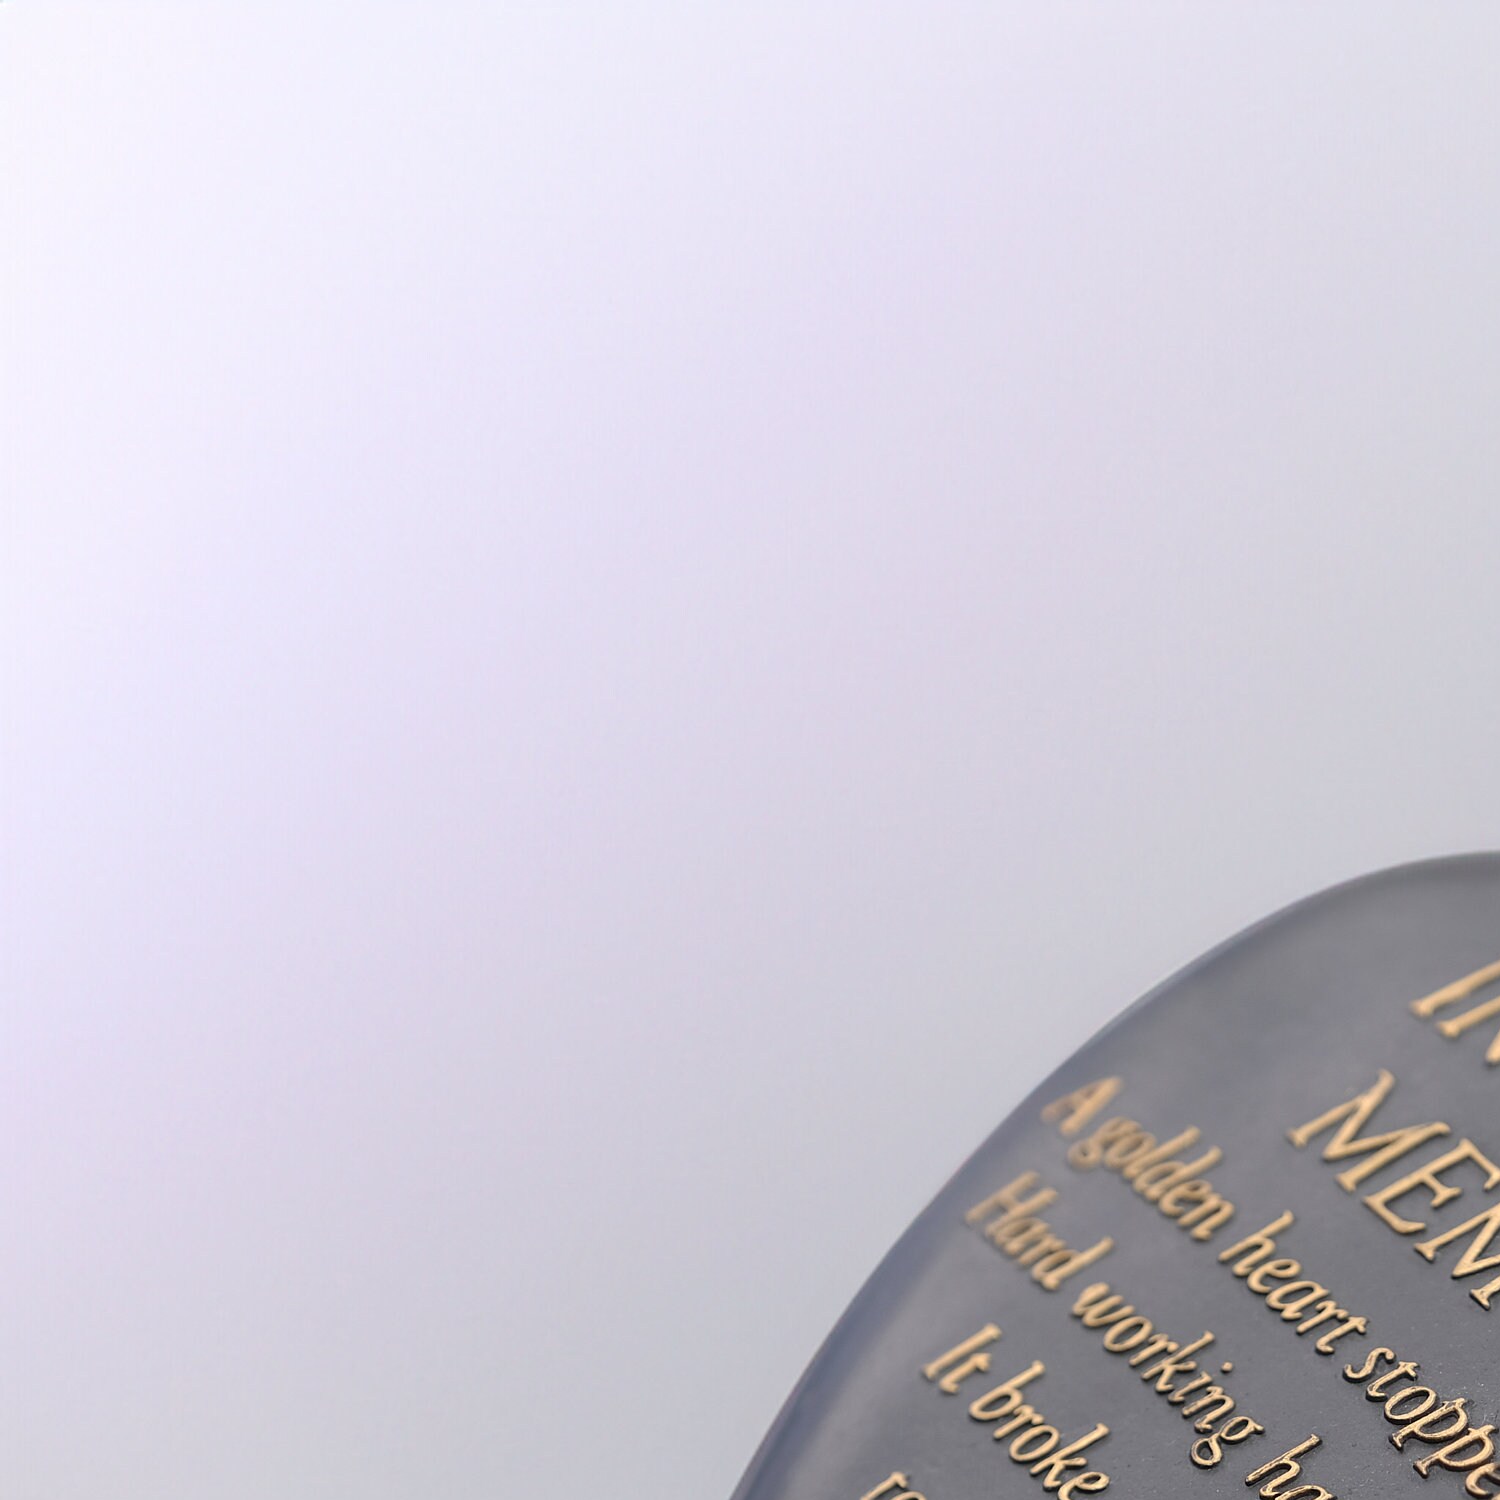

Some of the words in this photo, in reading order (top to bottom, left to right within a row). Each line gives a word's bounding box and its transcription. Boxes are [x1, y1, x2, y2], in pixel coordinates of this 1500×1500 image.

[1040, 1076, 1124, 1136] A
[1068, 1116, 1235, 1242] golden
[964, 1171, 1115, 1291] Hard
[1072, 1282, 1265, 1468] working
[1218, 1210, 1371, 1354] heart
[923, 1324, 1001, 1394] It
